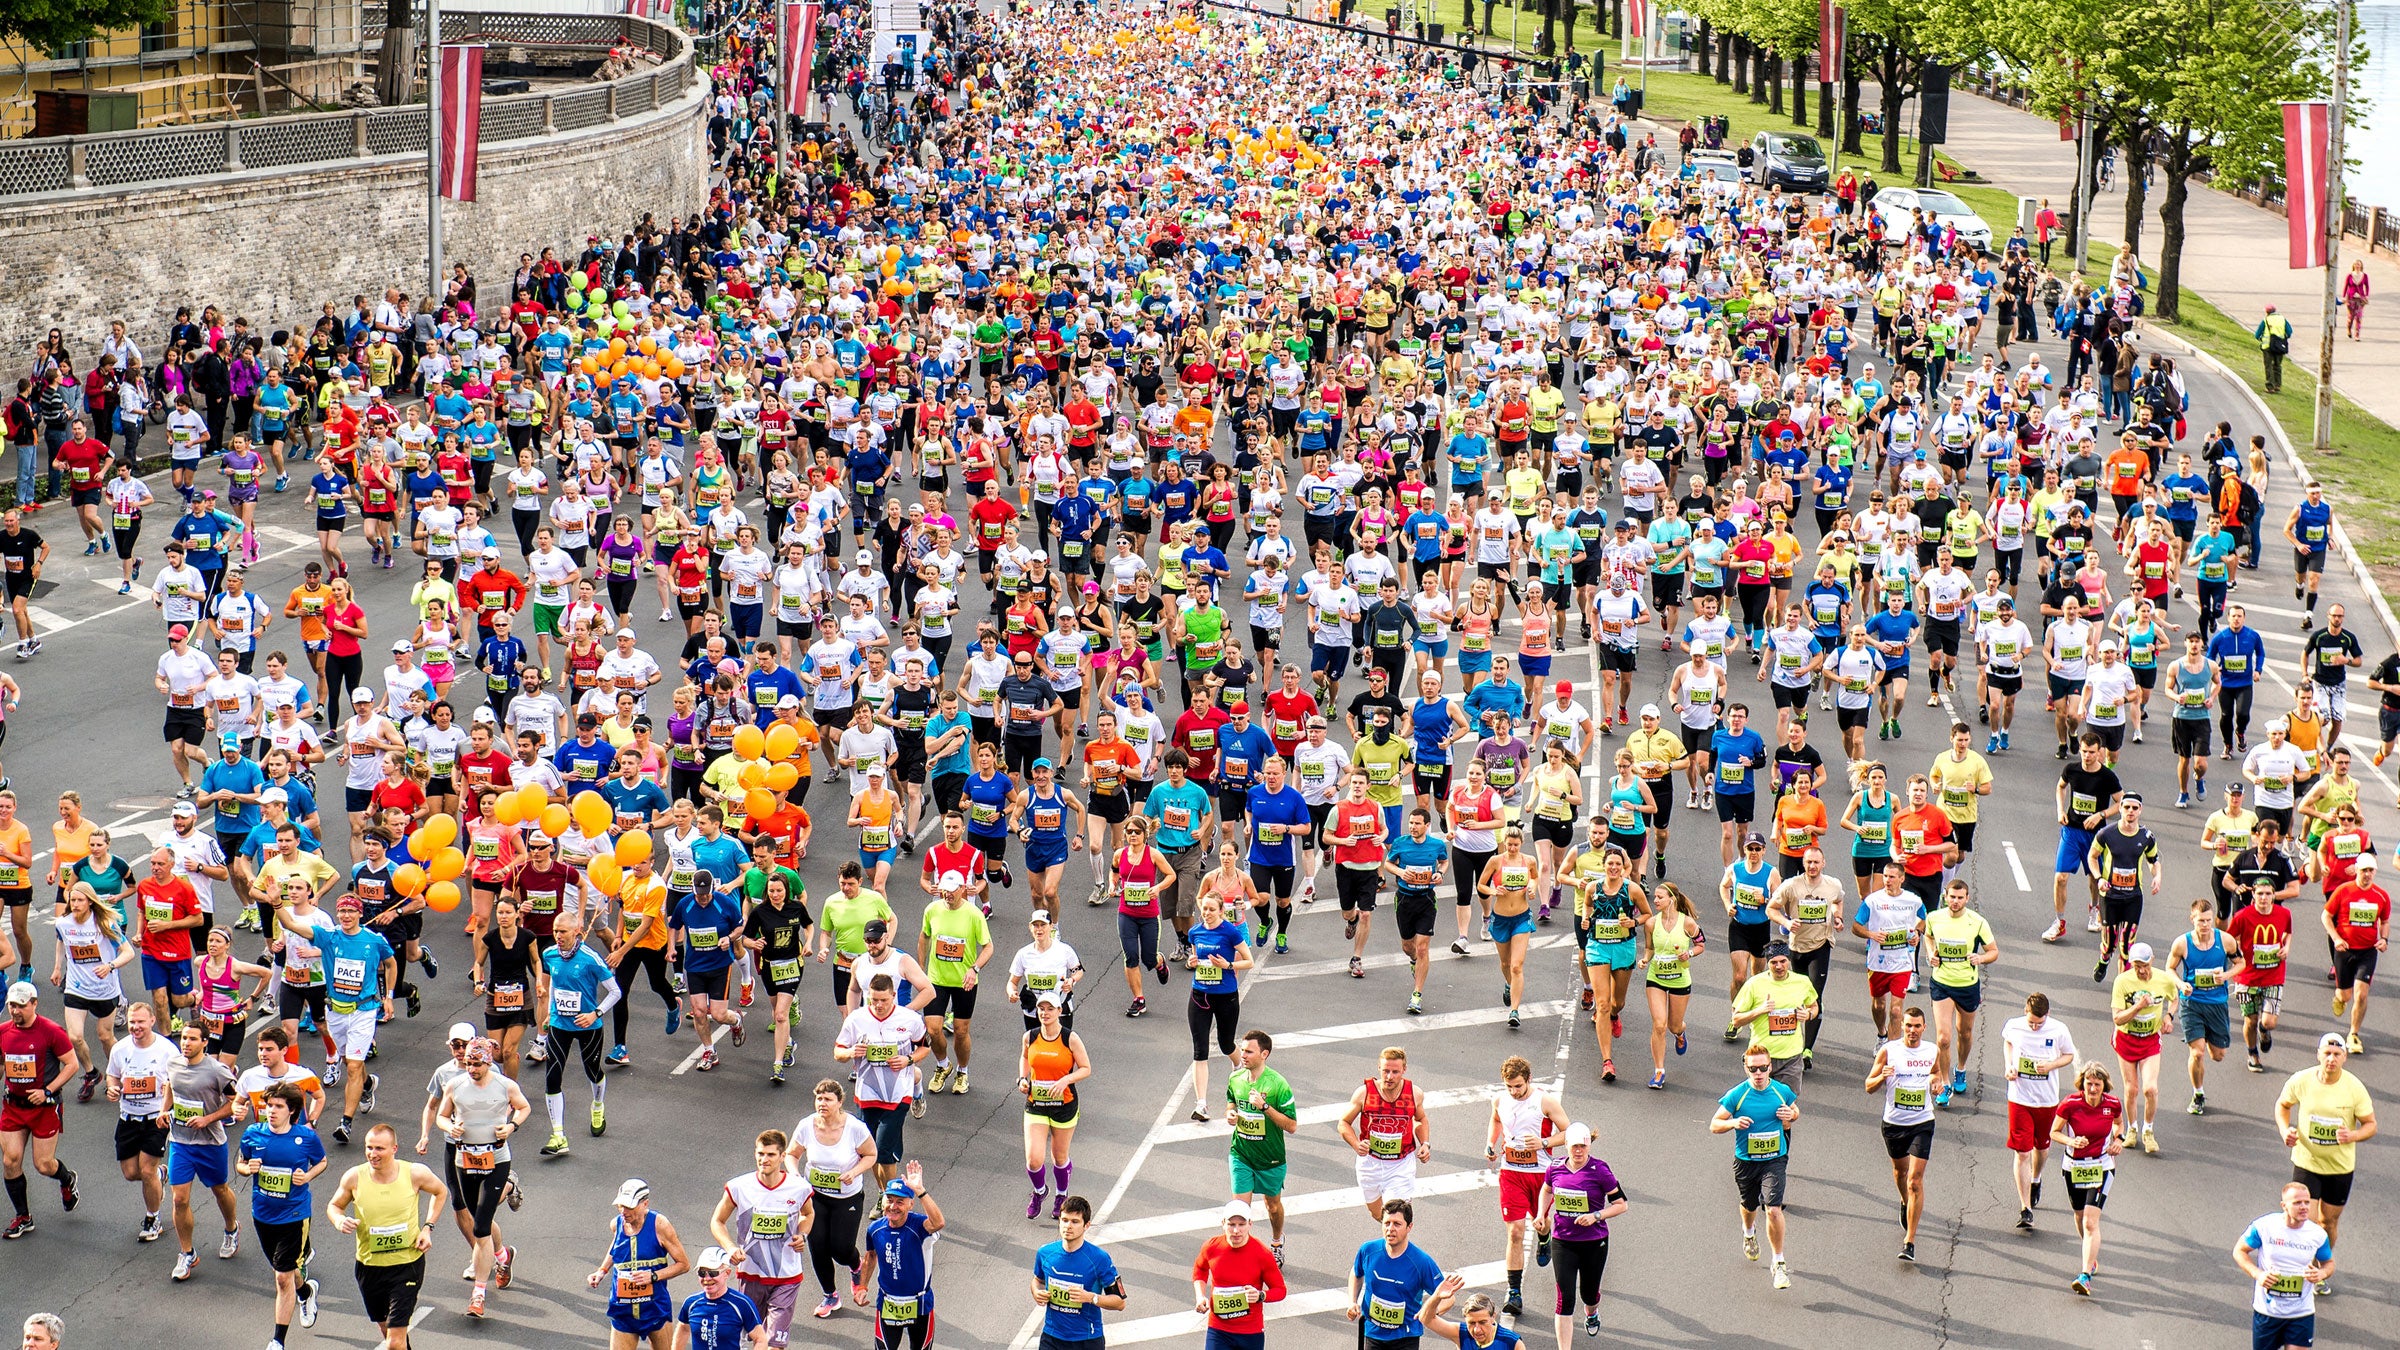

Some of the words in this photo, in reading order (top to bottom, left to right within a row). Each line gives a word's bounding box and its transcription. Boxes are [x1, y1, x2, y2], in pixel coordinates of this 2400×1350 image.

[1938, 604, 1952, 612] 1521
[1058, 655, 1074, 663] 5410
[1129, 727, 1146, 736] 3008
[1097, 766, 1108, 774] 123
[1228, 765, 1244, 773] 1641
[1305, 764, 1321, 772] 4643
[1371, 769, 1387, 777] 3477
[1494, 774, 1511, 782] 3476
[621, 818, 638, 826] 1139
[1040, 816, 1057, 824] 1214
[1168, 813, 1185, 823] 1049
[1354, 823, 1370, 832] 1115
[866, 833, 884, 842] 5147
[477, 844, 495, 853] 3047
[1414, 873, 1428, 881] 138
[1506, 874, 1525, 882] 2852
[2116, 875, 2133, 883] 1169
[362, 887, 379, 895] 1061
[1128, 889, 1146, 898] 3077
[149, 910, 168, 919] 4598
[1804, 906, 1824, 915] 4290
[1598, 927, 1618, 936] 2485
[695, 934, 714, 943] 3250
[74, 948, 94, 957] 1617
[943, 944, 958, 953] 532
[1943, 946, 1962, 956] 4501
[1659, 961, 1677, 970] 2484
[289, 969, 305, 979] 1104
[337, 967, 361, 978] PACE
[776, 964, 795, 977] 5716
[1199, 967, 1217, 976] 3151
[1032, 978, 1052, 987] 2888
[499, 994, 518, 1004] 1507
[1774, 1017, 1794, 1026] 1092
[871, 1047, 893, 1057] 2935
[12, 1063, 28, 1072] 544
[1906, 1059, 1933, 1067] BOSCH
[2023, 1060, 2034, 1069] 34
[130, 1079, 147, 1088] 986
[1900, 1093, 1922, 1102] 2938
[2314, 1127, 2337, 1137] 5016
[1374, 1140, 1396, 1149] 4062
[1754, 1139, 1776, 1149] 3818
[1510, 1150, 1532, 1159] 1080
[814, 1172, 835, 1184] 3520
[2076, 1169, 2098, 1179] 2644
[261, 1174, 284, 1186] 4801
[1559, 1197, 1582, 1206] 3385
[757, 1217, 782, 1228] 2936
[376, 1234, 403, 1246] 2765
[2268, 1237, 2313, 1250] lattelecom
[1052, 1289, 1069, 1301] 310
[1218, 1298, 1242, 1310] 5588
[888, 1303, 912, 1315] 3110
[1374, 1307, 1398, 1319] 3108
[1228, 1310, 1247, 1319] adidas
